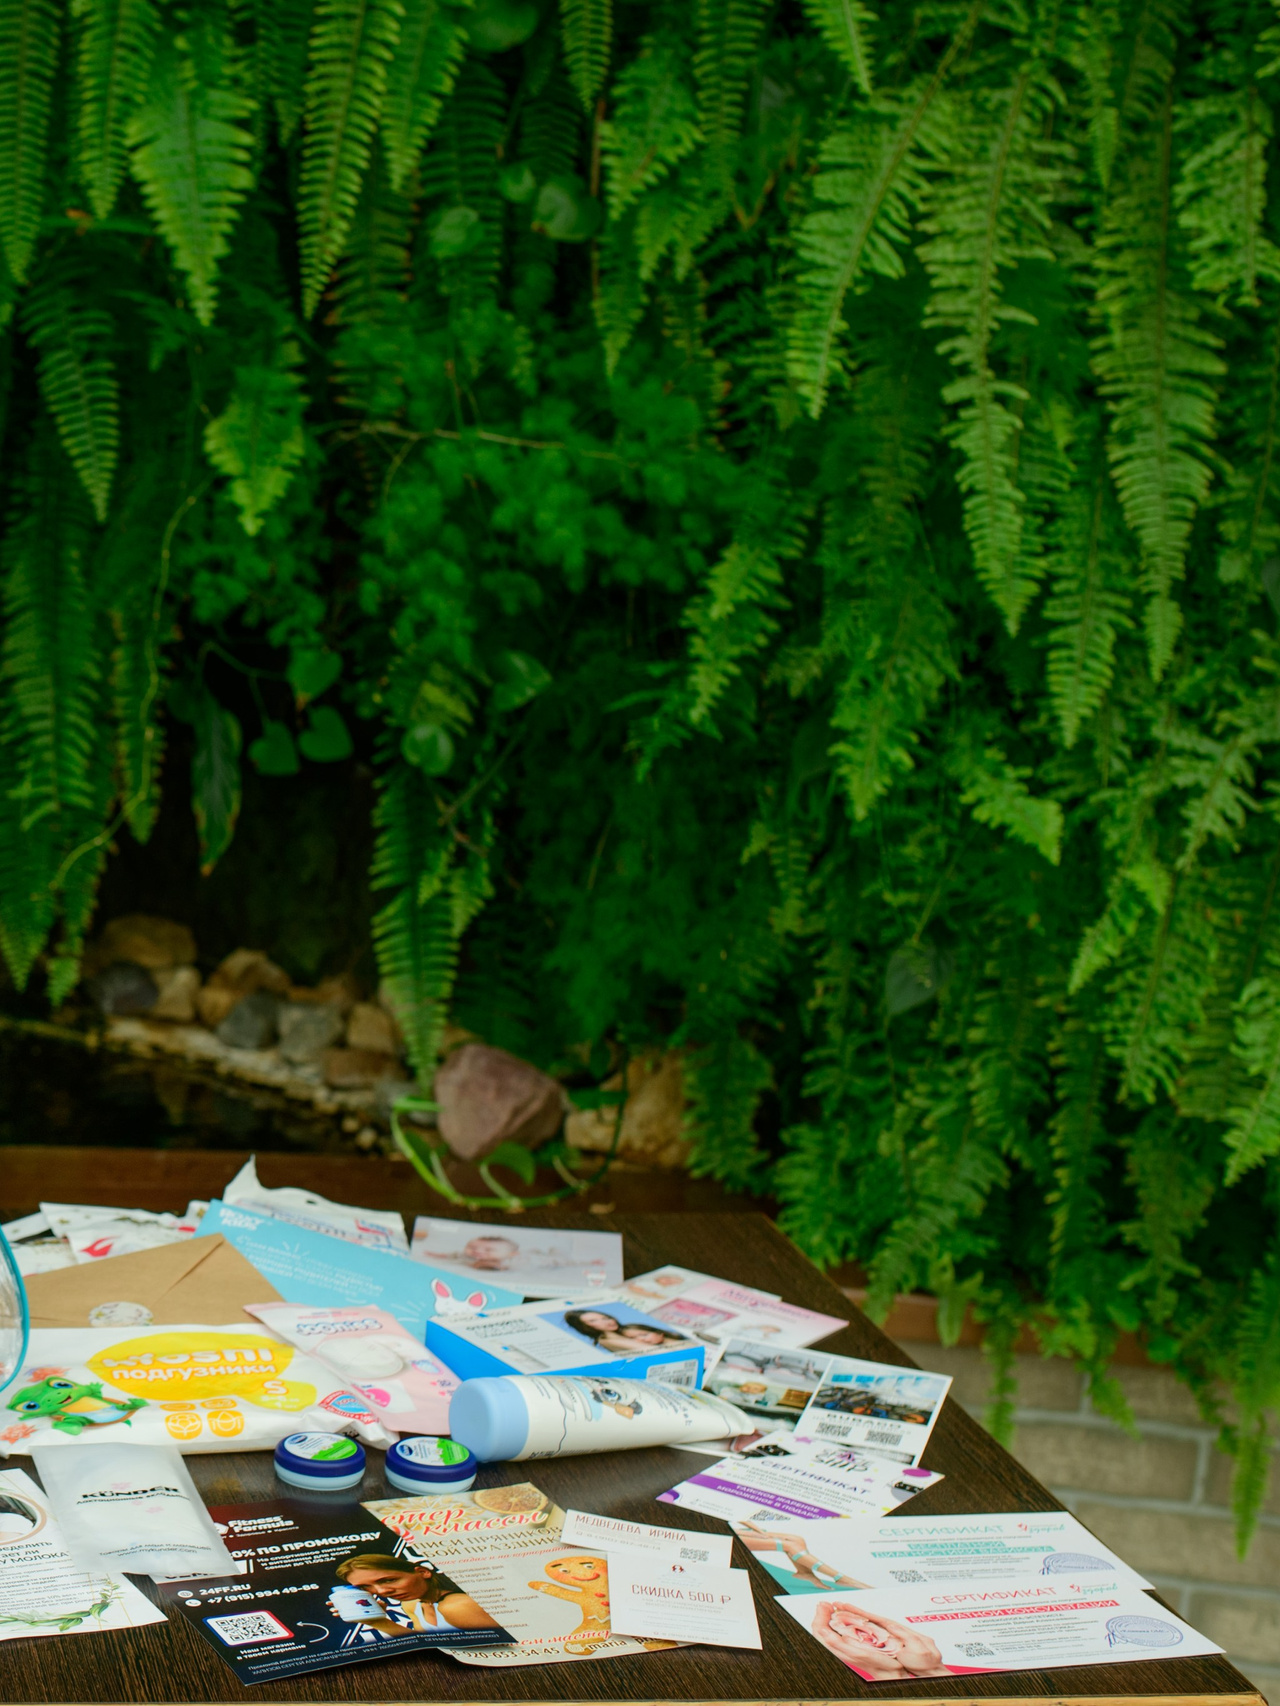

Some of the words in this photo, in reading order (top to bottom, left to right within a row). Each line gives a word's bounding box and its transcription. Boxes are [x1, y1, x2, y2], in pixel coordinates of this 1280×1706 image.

[112, 1364, 276, 1381] подгузники
[262, 1380, 289, 1395] S
[760, 1460, 871, 1495] СЕРТИФИКАТ
[81, 1486, 181, 1499] KÜNDER
[713, 1485, 774, 1505] МОРОЖЕНОЕ
[734, 1485, 778, 1499] ТАЙСКОЕ
[773, 1496, 822, 1512] ЖАРЕНОЕ
[228, 1516, 282, 1528] Fitness
[381, 1508, 464, 1526] стер
[423, 1511, 549, 1538] классы
[233, 1520, 294, 1533] Formula
[575, 1515, 641, 1535] МЕДВЕДЕВА
[649, 1527, 687, 1542] ИРИНА
[878, 1524, 1005, 1537] СЕРТИФИКАТ
[230, 1548, 256, 1559] 0%
[257, 1545, 281, 1555] ПО
[282, 1531, 381, 1552] ПРОМОКОДУ
[411, 1538, 466, 1551] ПИСИ
[422, 1546, 464, 1559] БОЙ
[268, 1556, 312, 1566] витамины
[313, 1553, 329, 1561] для
[330, 1549, 351, 1558] всей
[271, 1550, 320, 1562] спортивное
[321, 1544, 357, 1554] питание
[199, 1583, 251, 1595] 24FF.RU
[208, 1595, 222, 1603] +7
[224, 1591, 254, 1602] (915)
[255, 1588, 280, 1597] 994
[631, 1584, 685, 1600] СКИДКА
[688, 1591, 714, 1604] 500
[930, 1587, 1059, 1605] СЕРТИФИКАТ
[909, 1609, 1005, 1622] БЕСПЛАТНОЙ
[1004, 1600, 1117, 1614] КОНСУЛЬТАЦИИ
[243, 1651, 269, 1659] твоем
[270, 1644, 306, 1654] кармане
[260, 1642, 295, 1651] магазин
[462, 1647, 560, 1659] 920-653-54-45
[588, 1639, 627, 1651] maria
